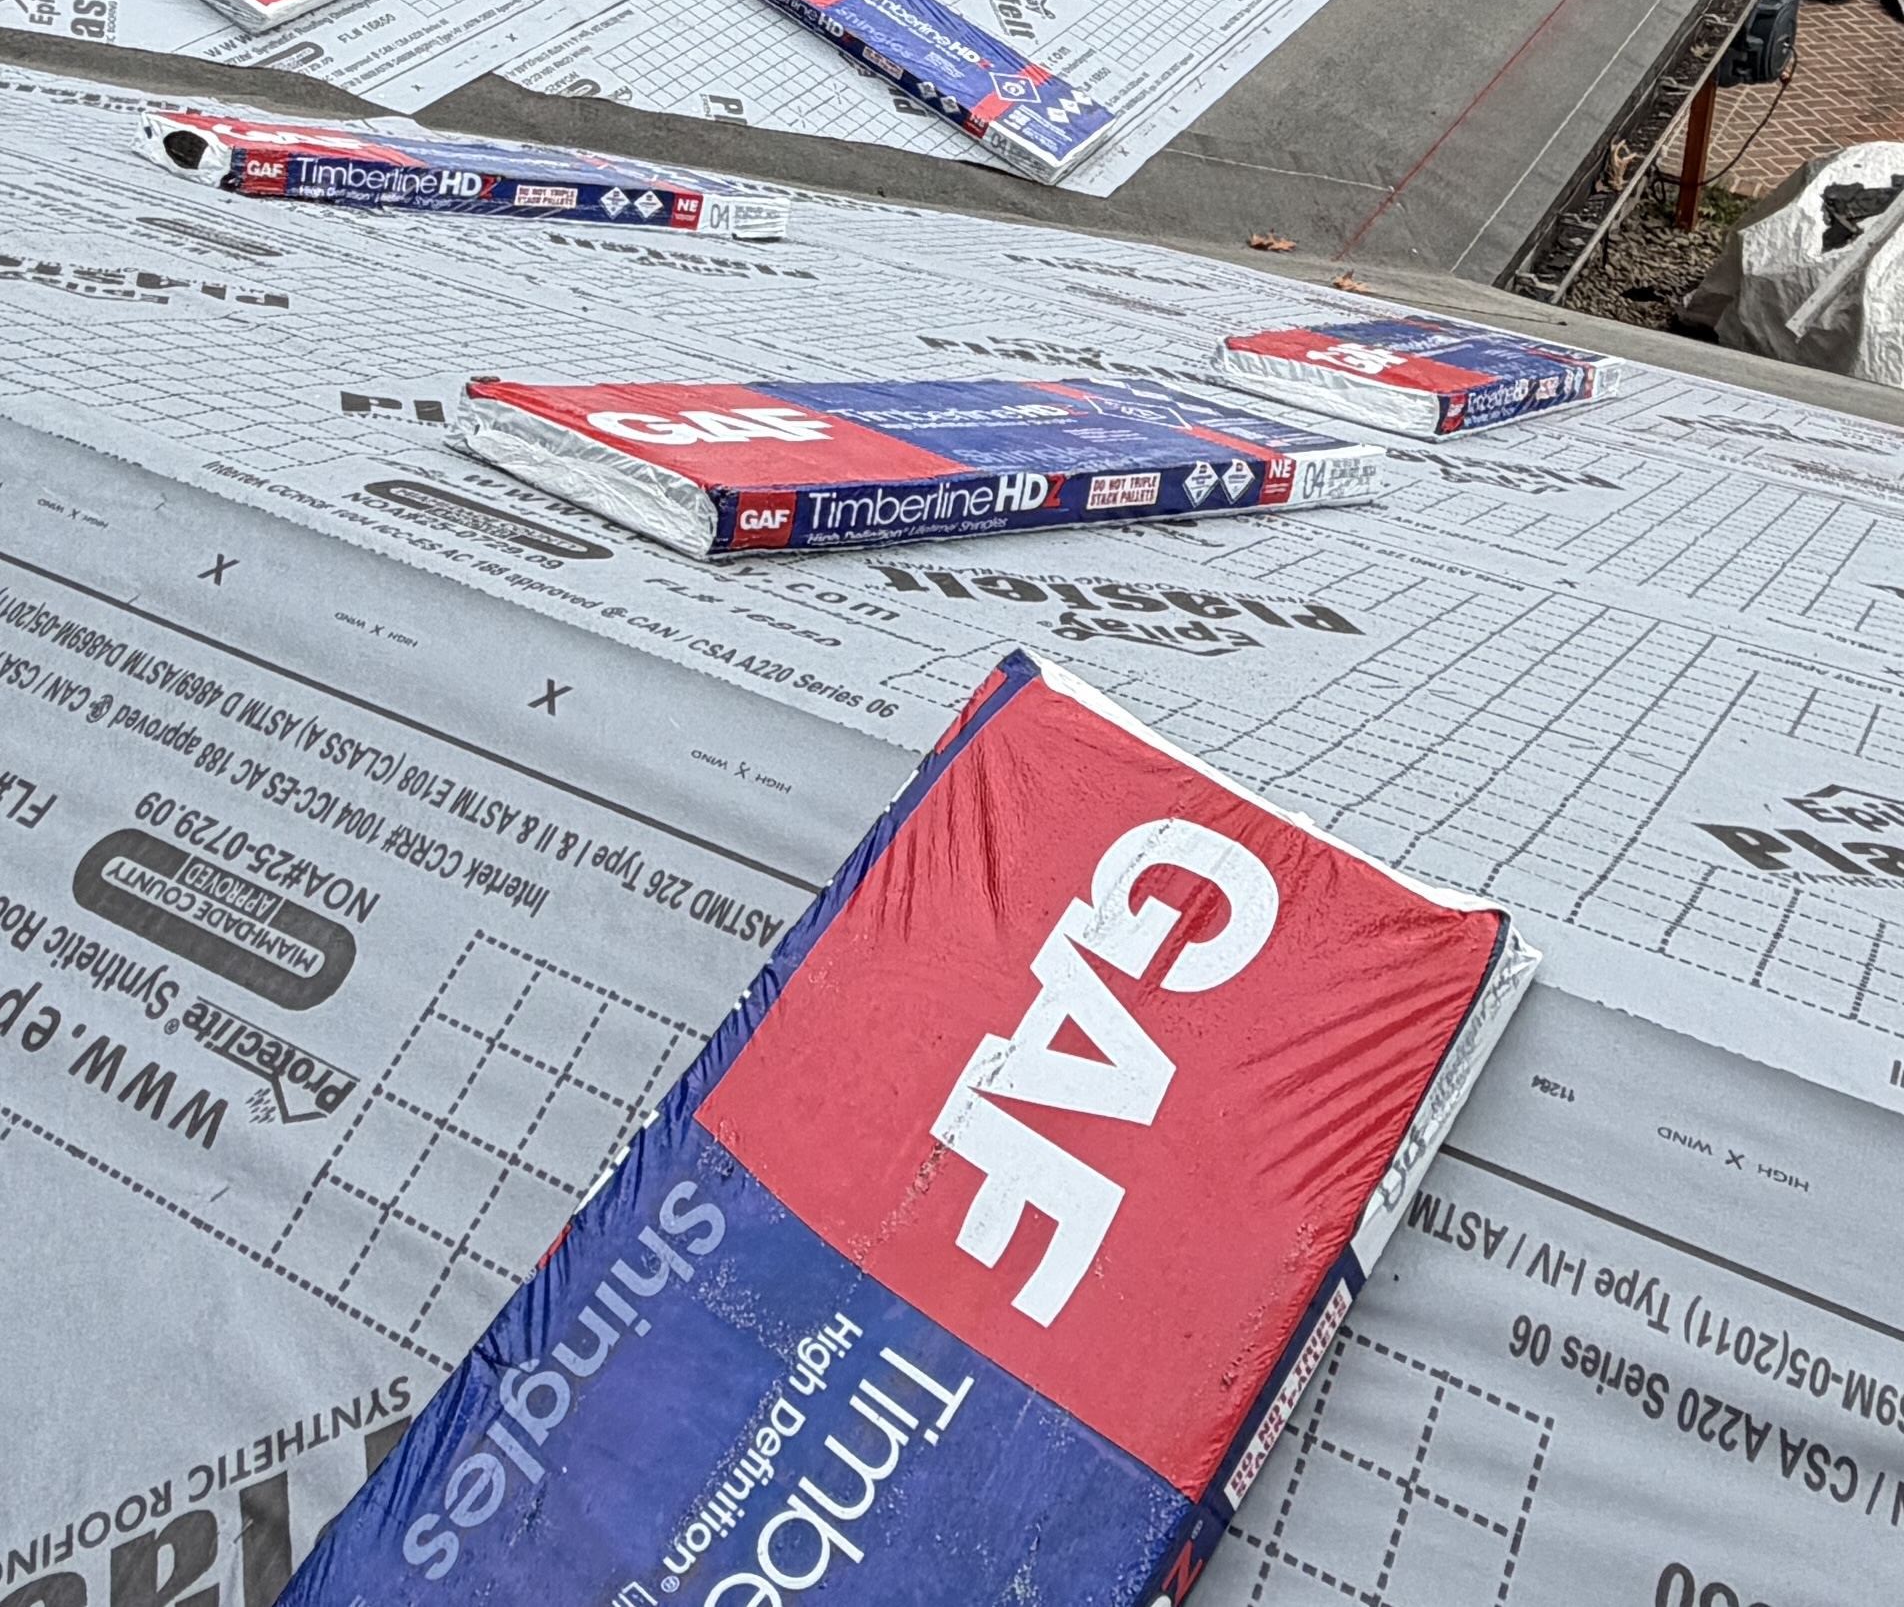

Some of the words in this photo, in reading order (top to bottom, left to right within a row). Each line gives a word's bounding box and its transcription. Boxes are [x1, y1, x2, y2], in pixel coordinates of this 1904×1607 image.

[246, 160, 283, 177] GAF
[297, 157, 437, 193] Timberline
[677, 199, 697, 211] NE
[1306, 342, 1410, 376] GAF
[588, 408, 841, 446] GAF
[1270, 459, 1291, 478] NE
[740, 509, 790, 530] GAF
[809, 482, 994, 529] Timberline
[870, 564, 1366, 638] Plasfelt
[733, 656, 795, 683] A220
[793, 674, 864, 708] Series
[865, 699, 899, 718] 06
[107, 701, 203, 756] approved
[237, 693, 304, 742] ASTM
[319, 731, 408, 787] (CLASS
[397, 764, 457, 809] E108
[455, 792, 523, 834] ASTM
[134, 790, 382, 926] NOA#25-0729.09
[595, 843, 646, 893] Type
[103, 858, 196, 918] COUNTY
[186, 861, 283, 921] APPROVED
[463, 856, 551, 919] Intertek
[643, 868, 694, 909] 226
[189, 889, 320, 975] MIAMI-DADE
[689, 889, 785, 949] ASTMD
[43, 924, 181, 1023] Synthetic
[930, 817, 1279, 1328] GAF
[1656, 1124, 1715, 1158] WIND
[1755, 1160, 1812, 1194] HIGH
[1405, 1189, 1508, 1261] ASTM
[1594, 1265, 1672, 1336] Type
[787, 1312, 865, 1397] High
[1508, 1312, 1554, 1366] 06
[1558, 1334, 1672, 1421] Series
[186, 1374, 414, 1503] SYNTHETIC
[1676, 1384, 1774, 1463] A220
[1778, 1426, 1861, 1505] CSA
